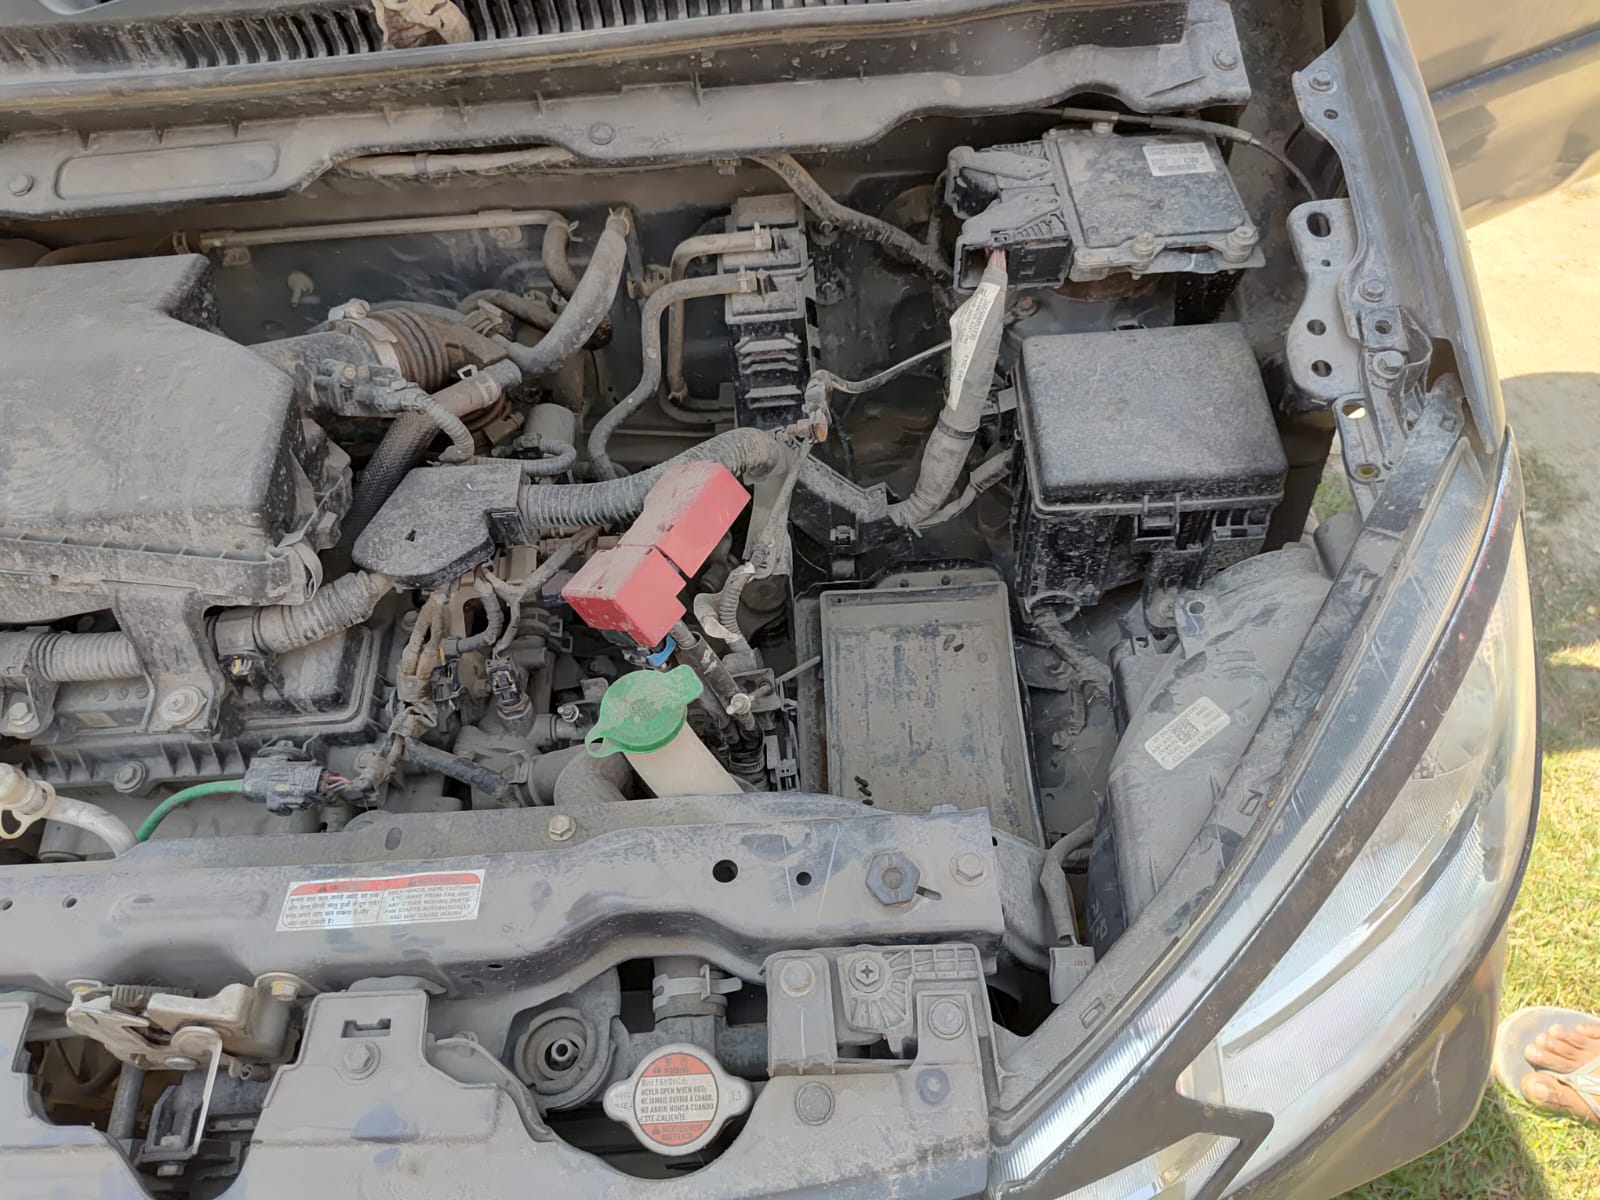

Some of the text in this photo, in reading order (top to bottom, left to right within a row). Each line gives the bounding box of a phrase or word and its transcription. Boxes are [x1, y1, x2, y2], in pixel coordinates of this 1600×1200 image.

[641, 1088, 659, 1096] NEVER
[660, 1087, 676, 1095] OPEN
[677, 1086, 692, 1094] WHEN
[649, 1096, 668, 1104] JAMAIS
[650, 1105, 668, 1113] ABRIR
[669, 1104, 689, 1112] NUNCA
[690, 1102, 714, 1111] CUANDO
